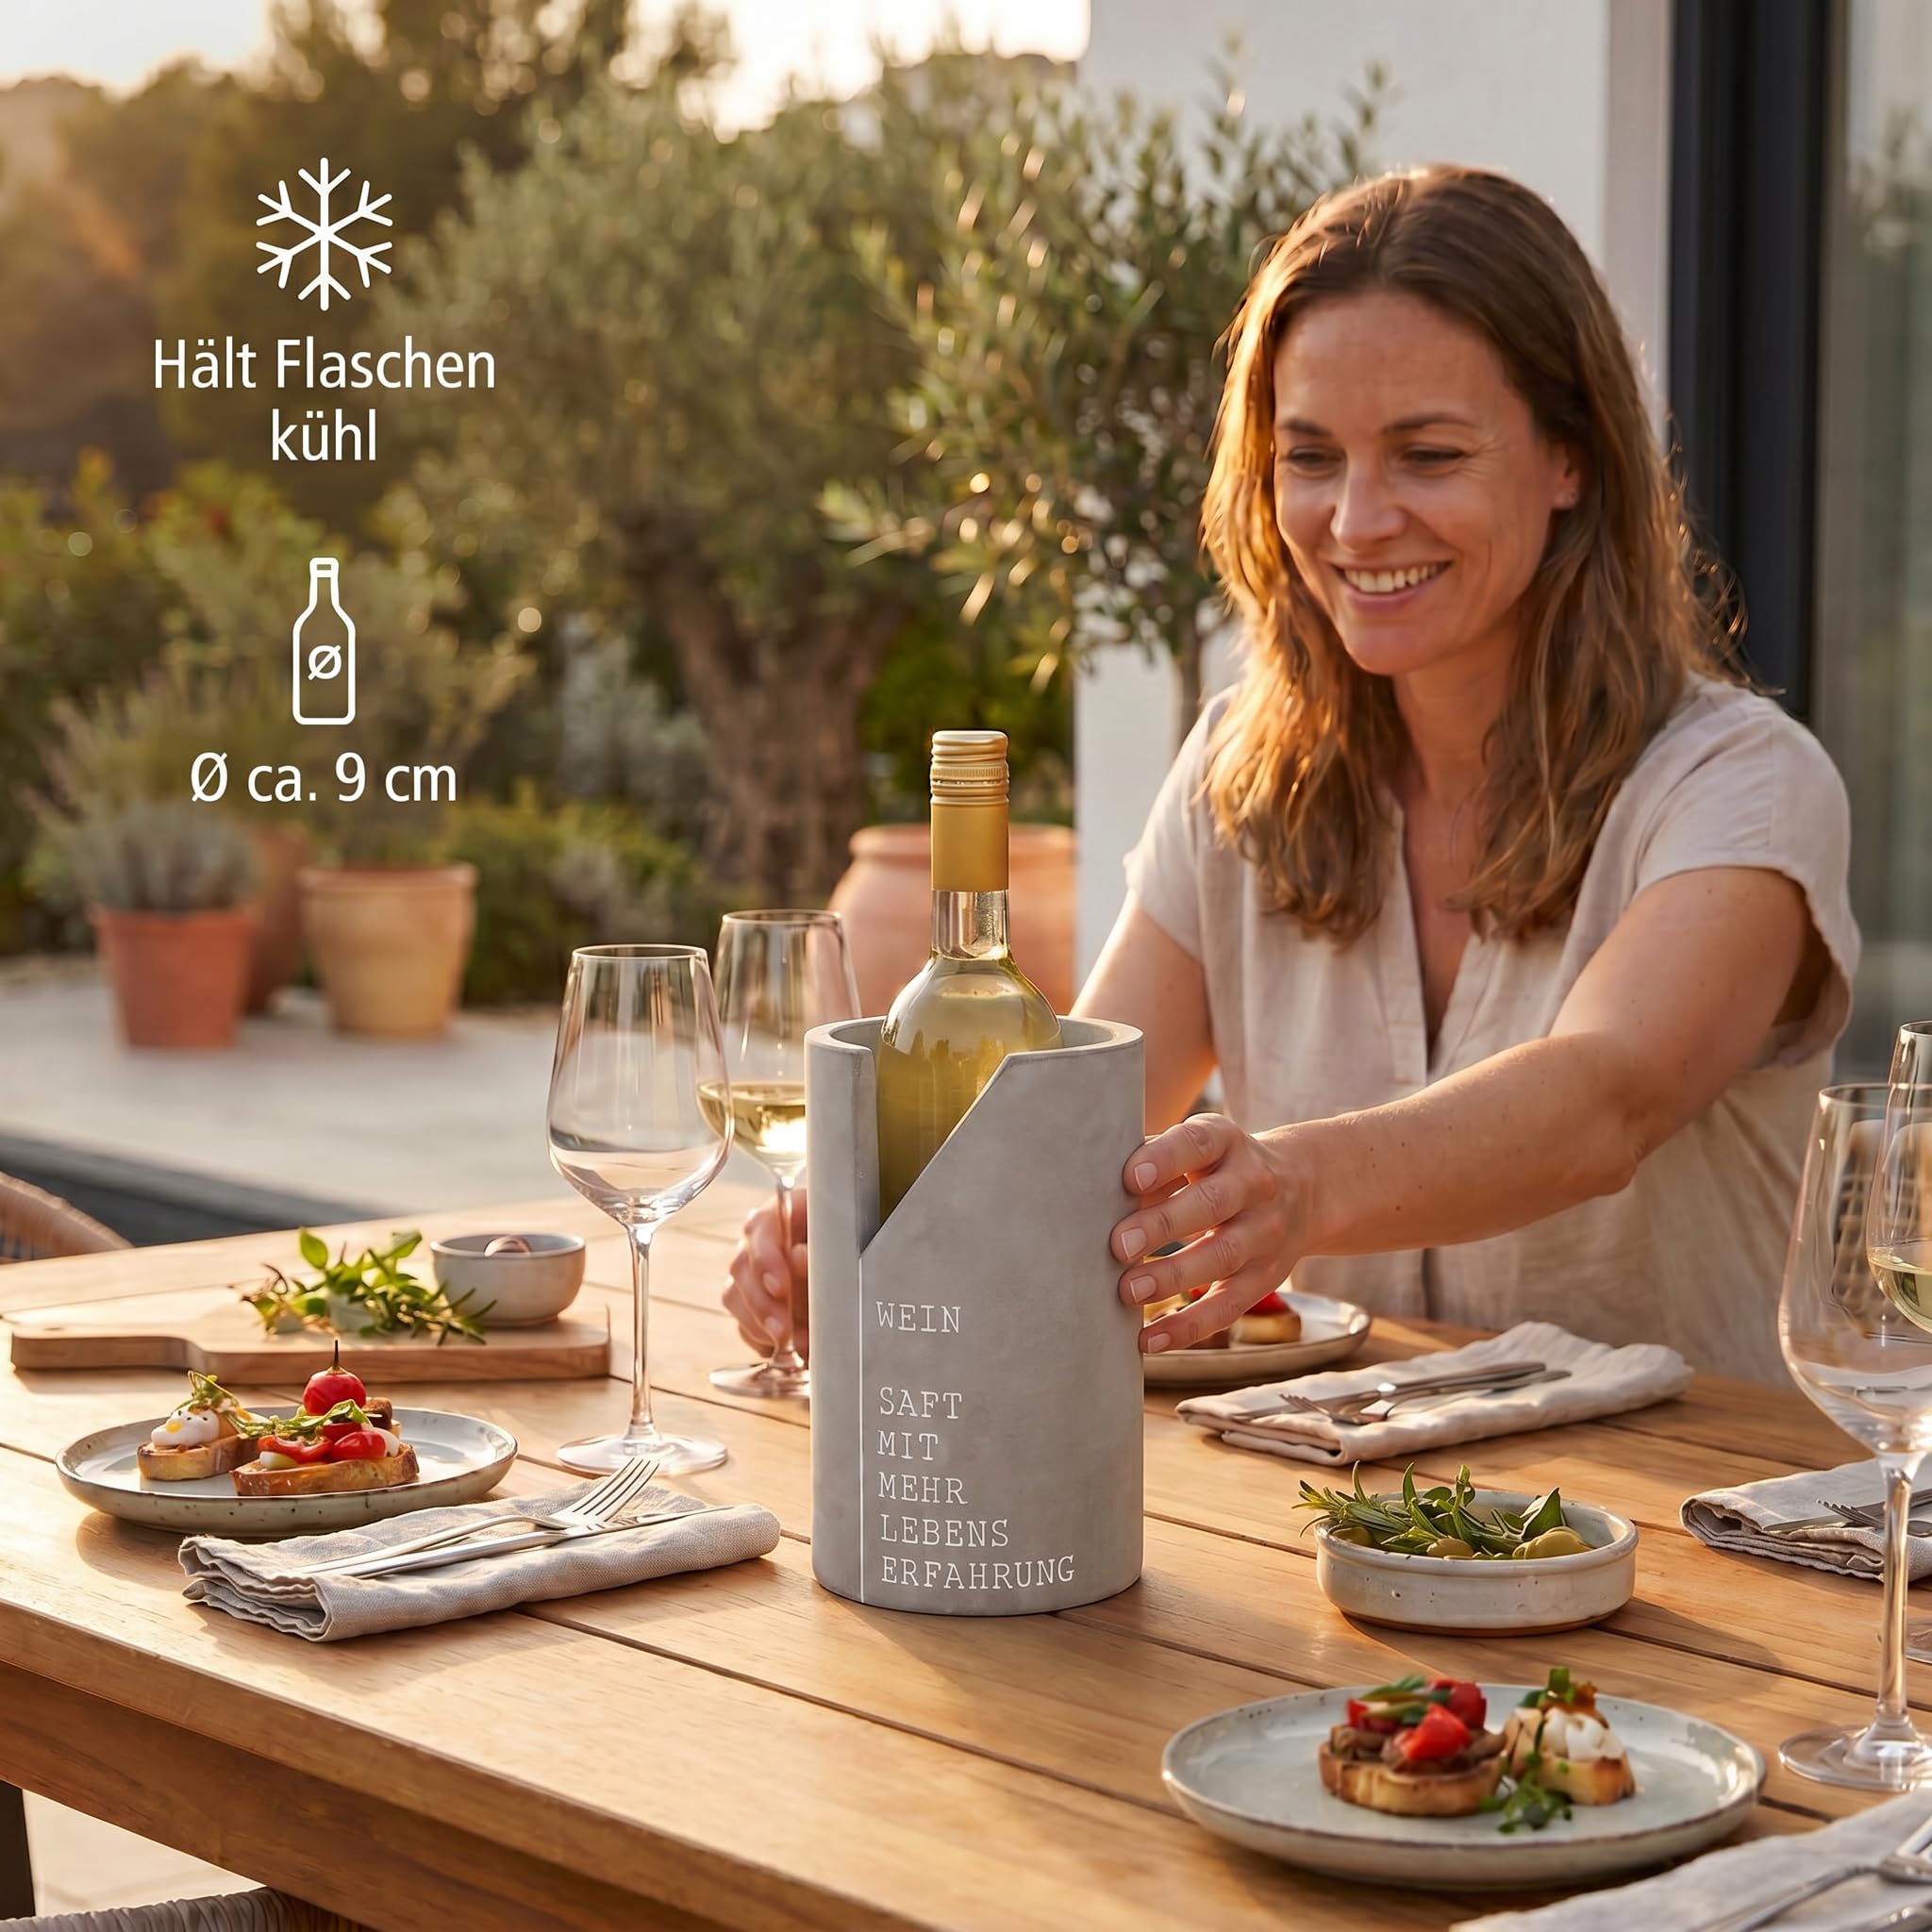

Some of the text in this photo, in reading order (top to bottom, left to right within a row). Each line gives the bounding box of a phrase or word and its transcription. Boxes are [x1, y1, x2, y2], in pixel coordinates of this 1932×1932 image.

[875, 1300, 961, 1334] WEIN
[879, 1386, 963, 1420] SAFT
[877, 1429, 939, 1460] MIT
[878, 1471, 969, 1505] MEHR
[881, 1513, 1009, 1548] LEBENS
[881, 1554, 1075, 1591] ERFAHRUNG
